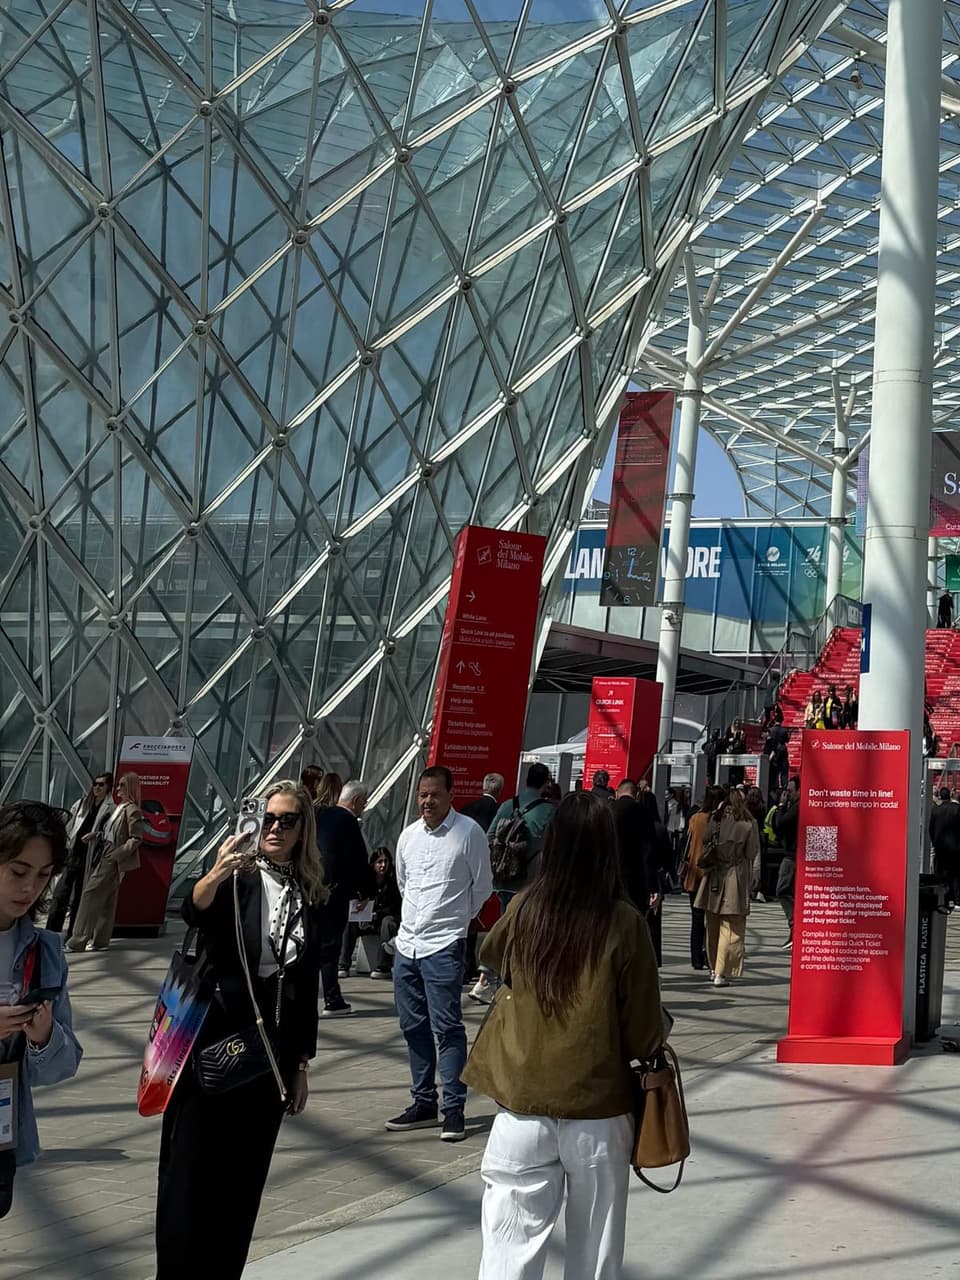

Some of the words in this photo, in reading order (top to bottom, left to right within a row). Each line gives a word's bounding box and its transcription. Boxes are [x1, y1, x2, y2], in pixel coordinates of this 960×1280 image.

[498, 540, 522, 550] Salone
[497, 549, 509, 558] del
[627, 548, 637, 556] 12
[496, 560, 520, 570] Milano
[822, 742, 844, 750] Salone
[845, 742, 855, 750] del
[808, 788, 828, 797] Don't
[852, 789, 869, 797] time
[808, 800, 822, 808] Non
[824, 800, 849, 809] perdere
[850, 801, 872, 809] tempo
[880, 800, 898, 808] coda!
[802, 930, 824, 938] Compila
[920, 917, 928, 948] PLASTIC
[919, 953, 927, 994] PLASTICA
